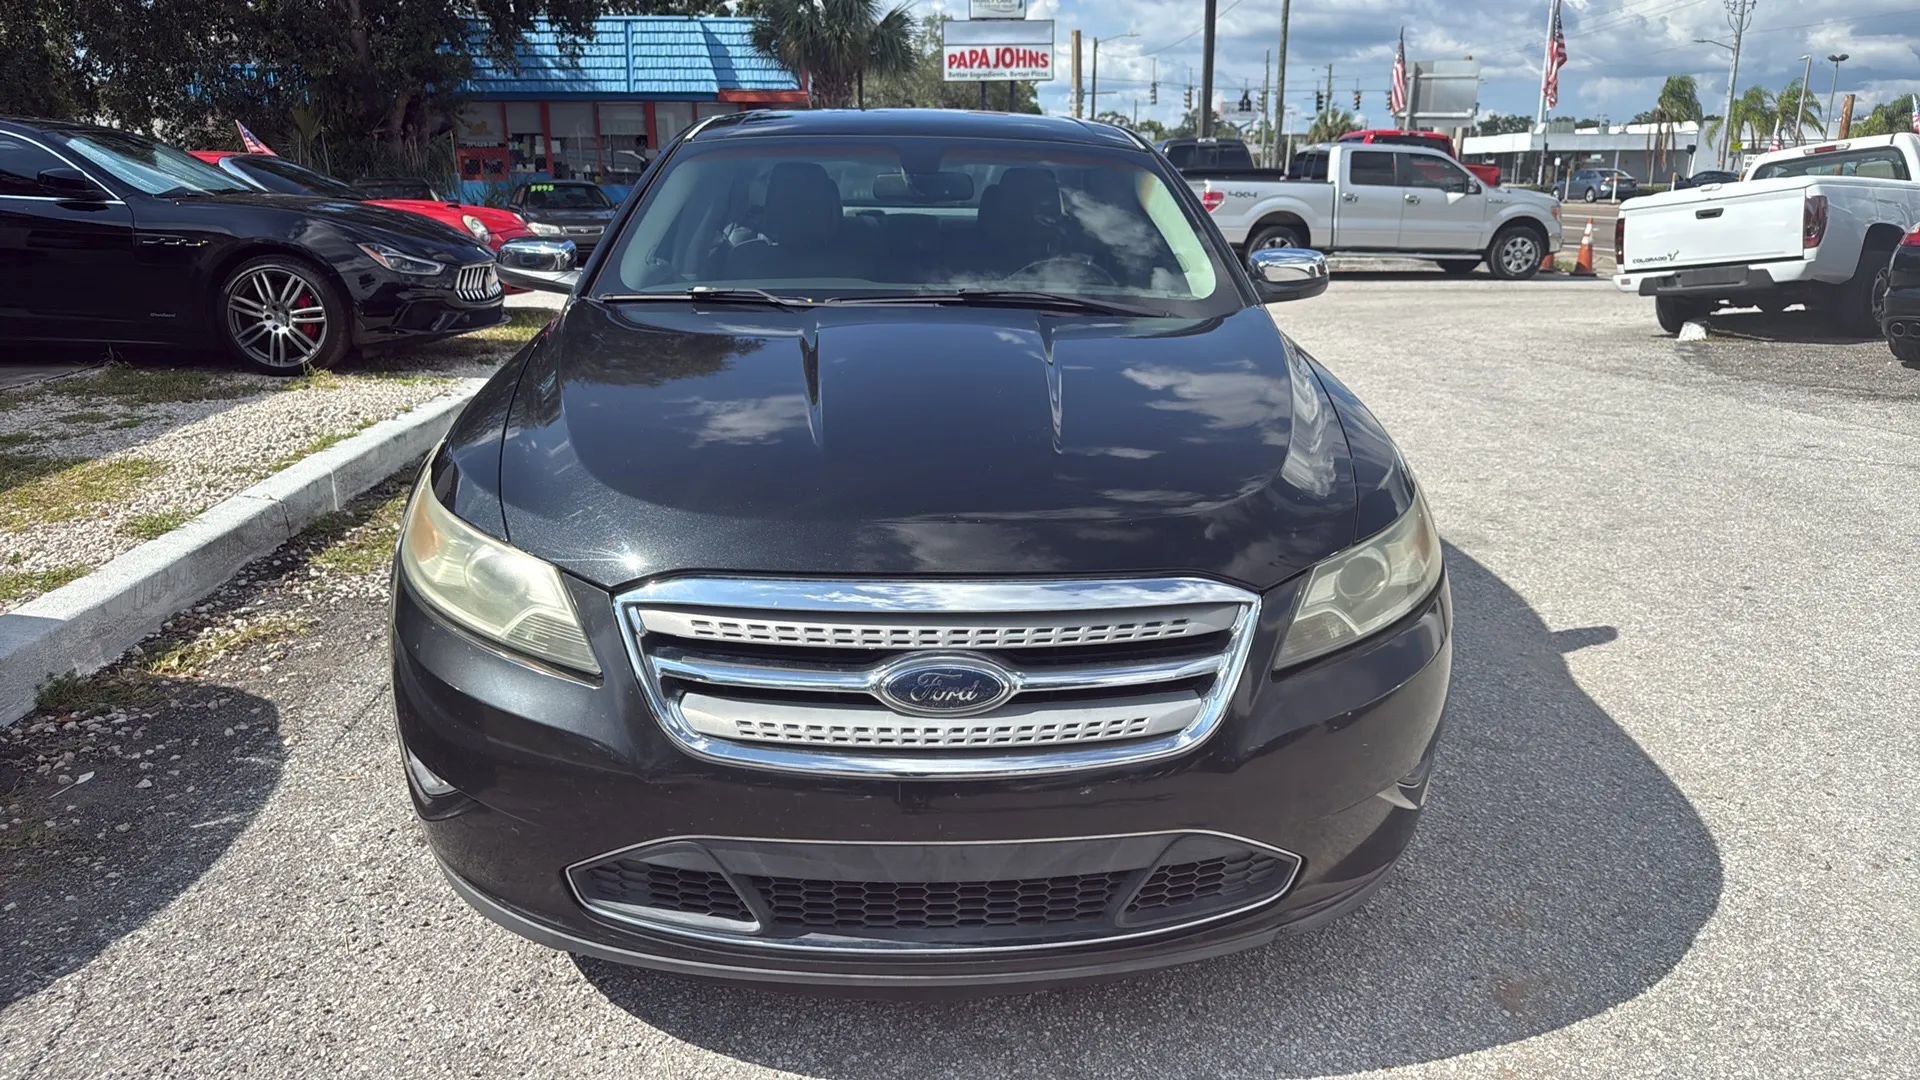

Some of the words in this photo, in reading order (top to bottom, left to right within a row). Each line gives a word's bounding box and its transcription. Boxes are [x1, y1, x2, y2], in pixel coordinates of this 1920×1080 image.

[948, 48, 990, 68] PAPA
[993, 47, 1049, 68] JOHNS
[1632, 256, 1667, 264] COLORADO
[910, 672, 979, 701] Ford
